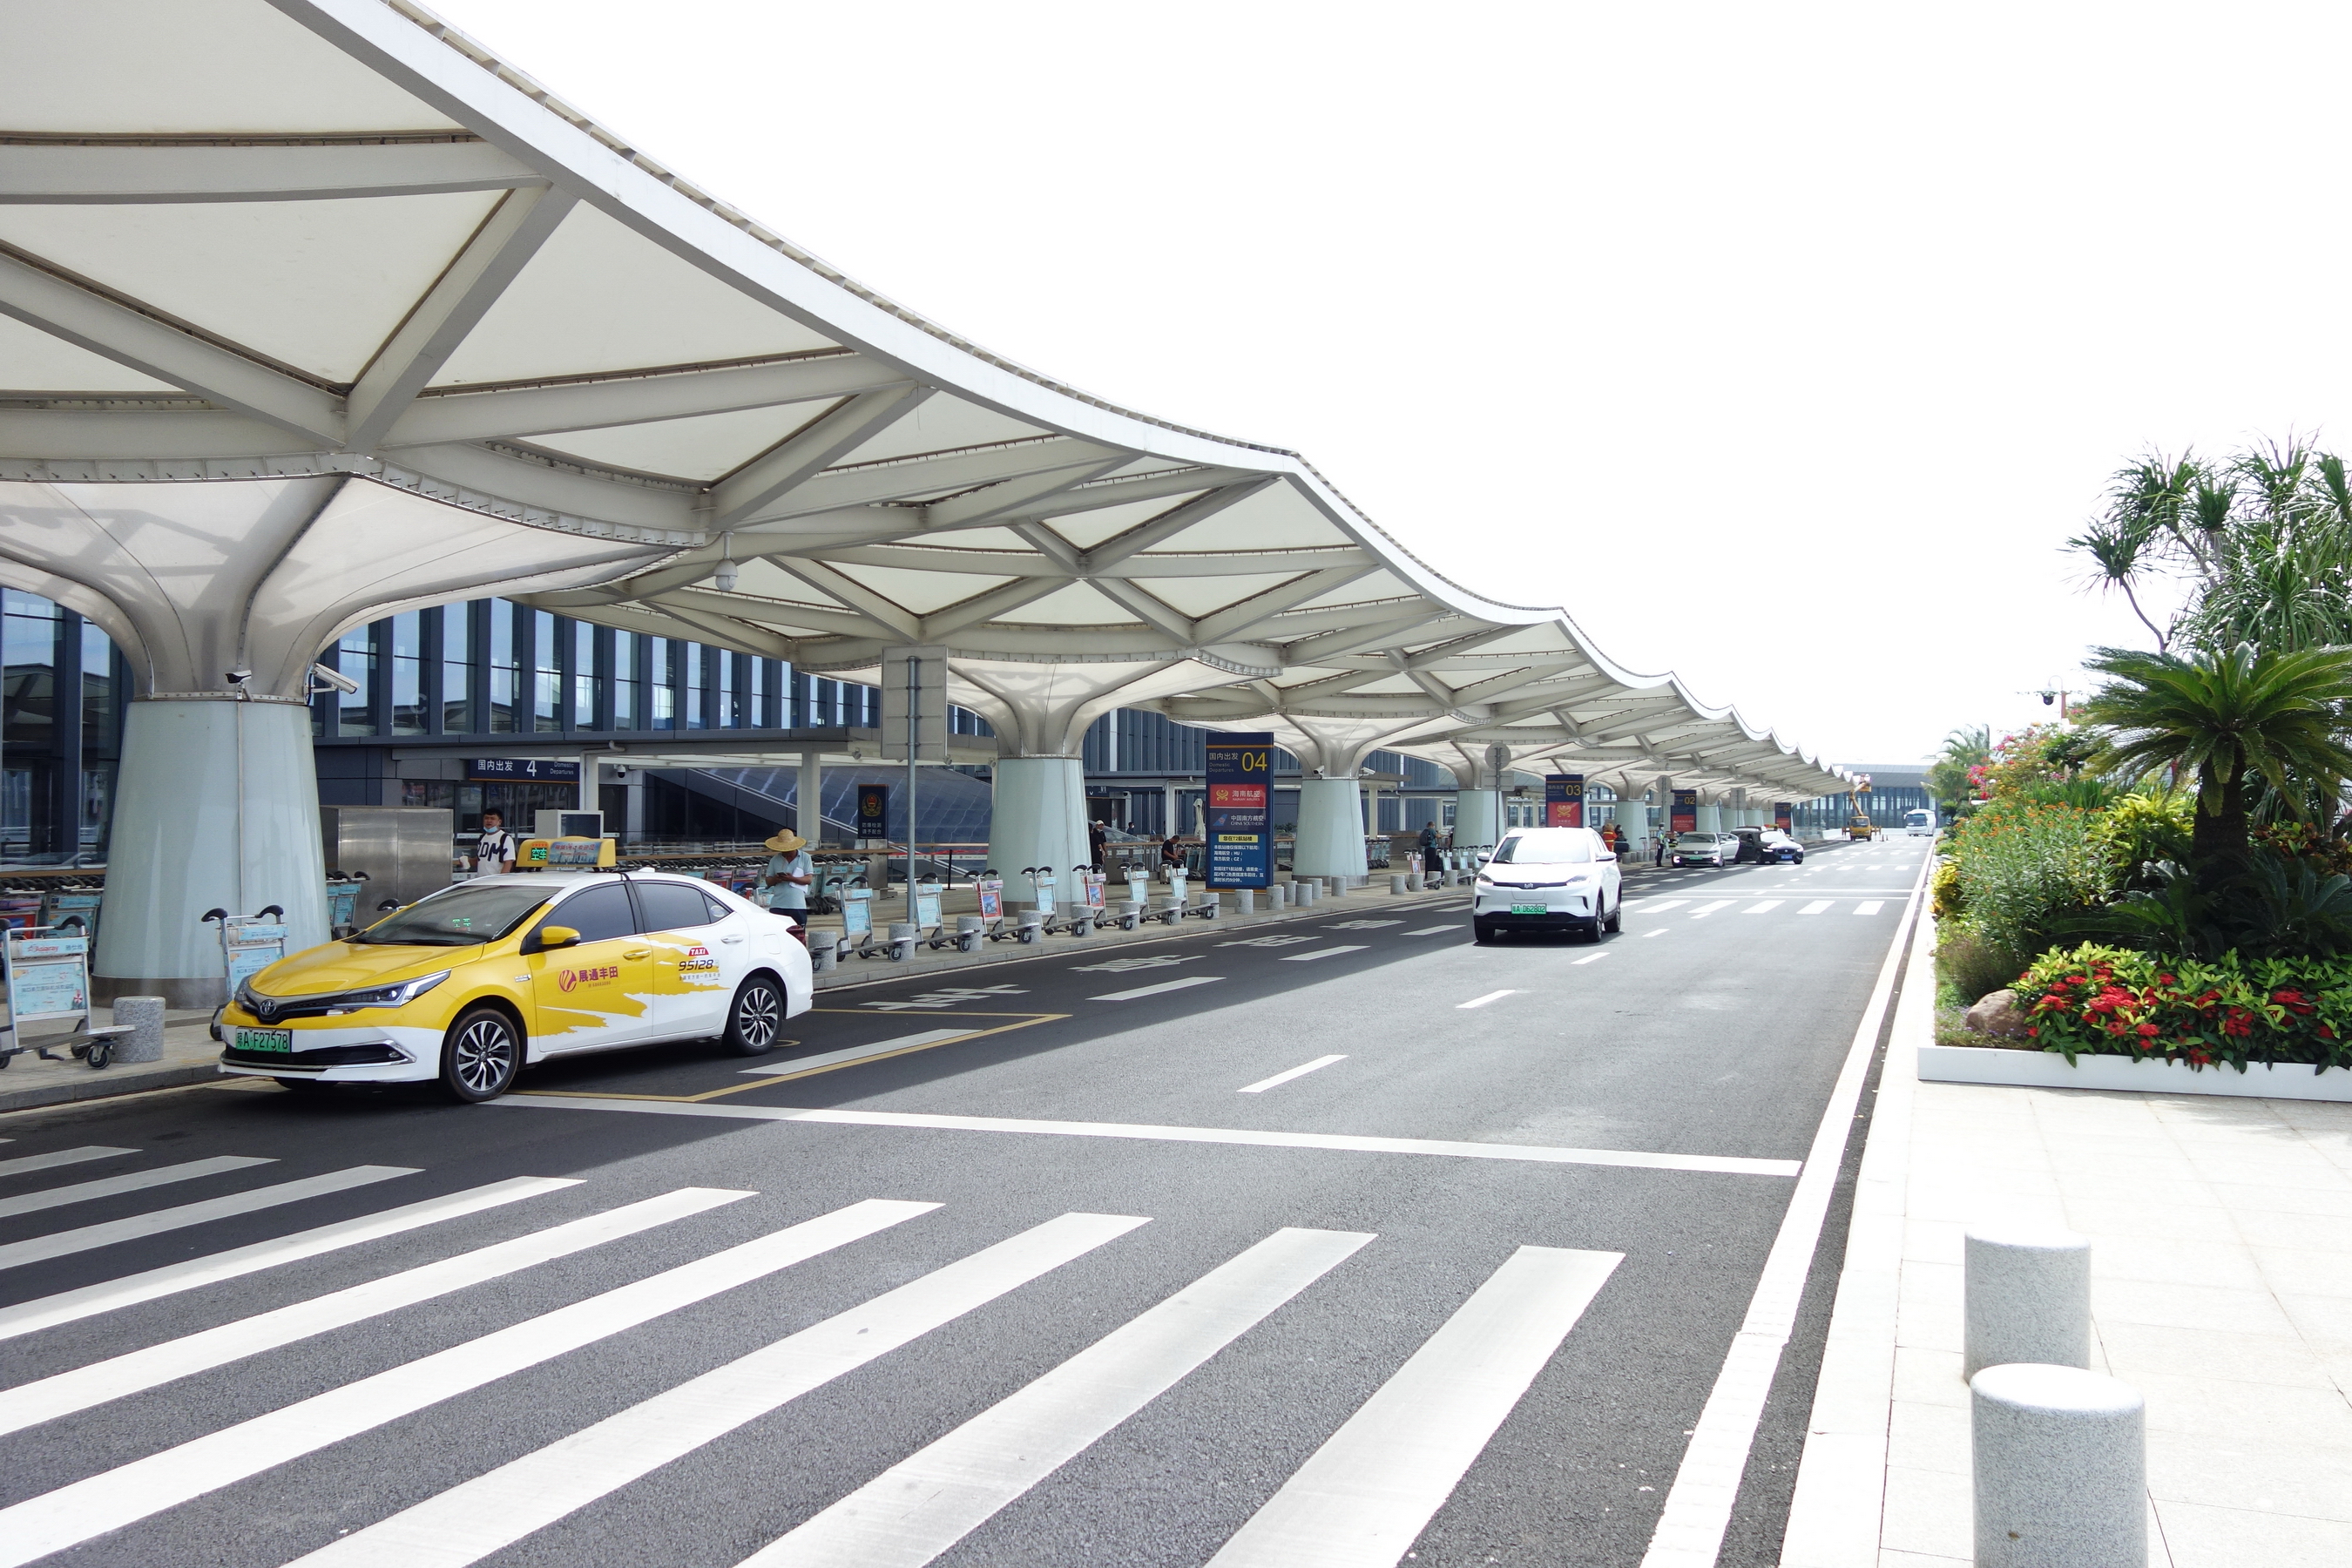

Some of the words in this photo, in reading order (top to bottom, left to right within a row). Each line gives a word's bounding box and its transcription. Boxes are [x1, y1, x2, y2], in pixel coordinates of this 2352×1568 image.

[477, 759, 514, 772] 国内出发
[526, 760, 537, 777] 4
[1241, 752, 1267, 772] 04
[1565, 784, 1581, 796] 03
[1684, 796, 1695, 805] 02
[531, 847, 547, 861] 空车
[678, 959, 714, 972] 95128
[578, 966, 618, 983] 展通丰田
